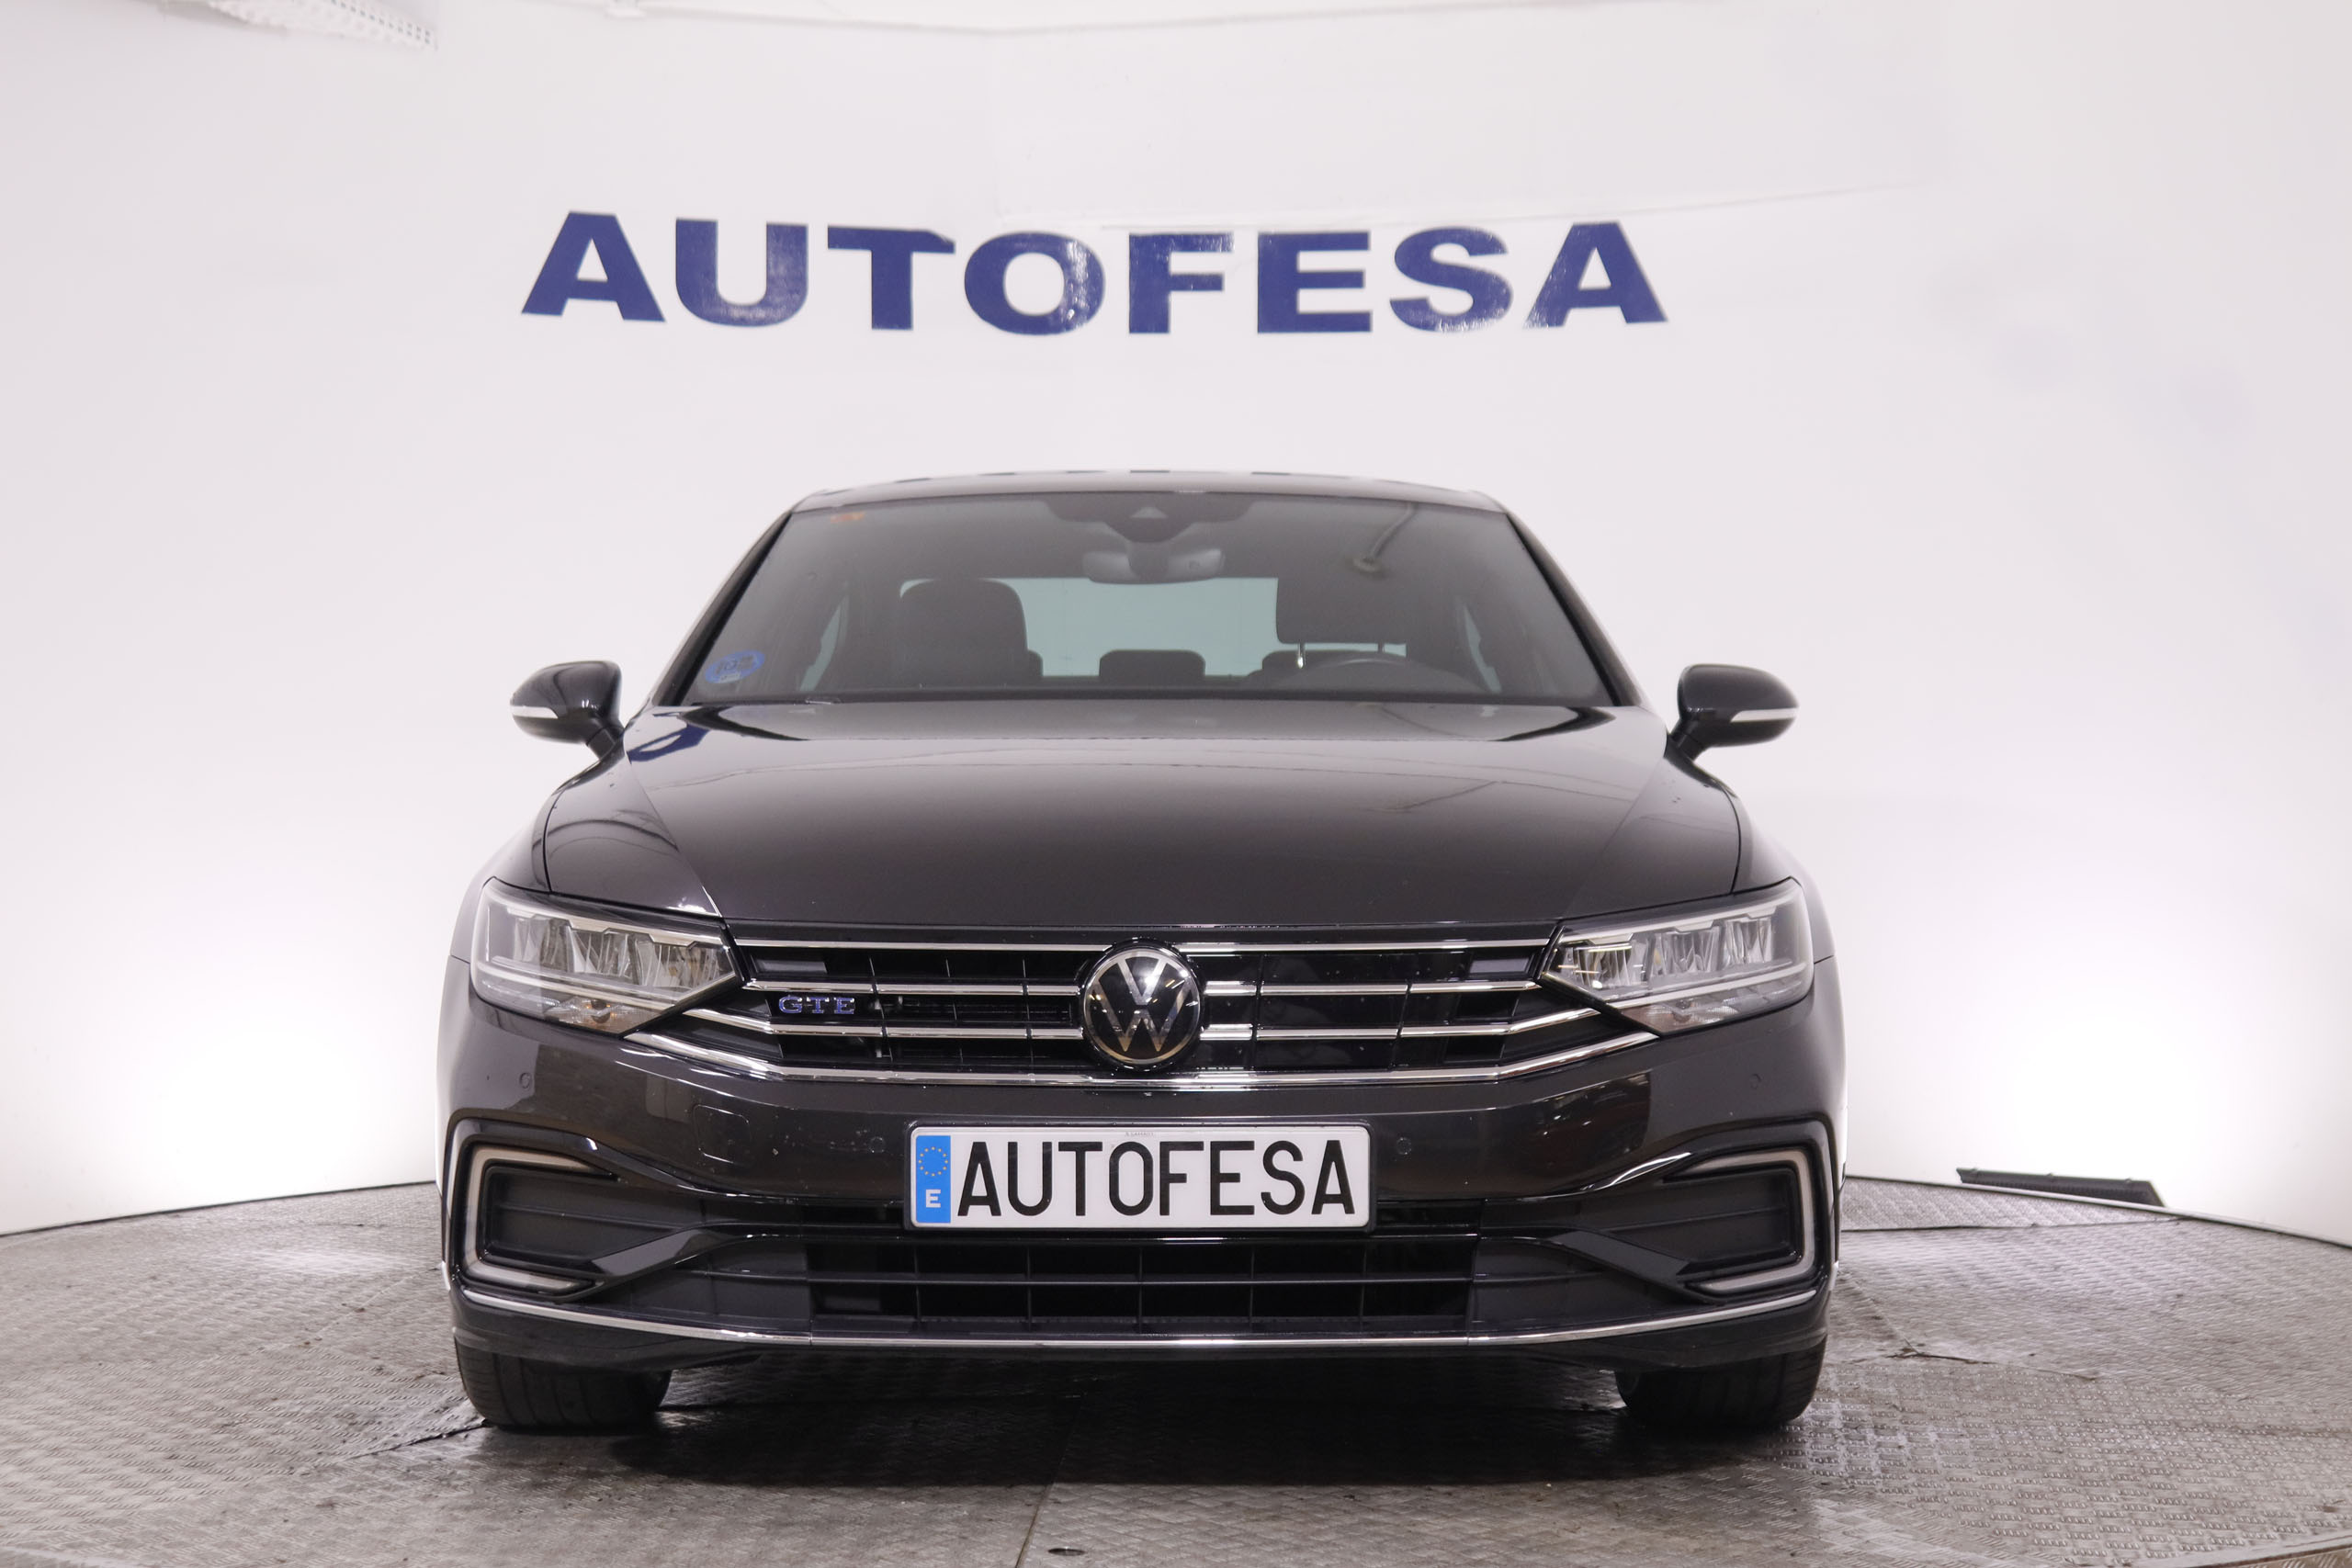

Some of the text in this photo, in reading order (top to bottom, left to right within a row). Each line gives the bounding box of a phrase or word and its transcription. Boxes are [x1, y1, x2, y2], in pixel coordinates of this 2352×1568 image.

[521, 211, 1668, 335] AUTOFESA
[778, 996, 855, 1015] GTE
[925, 1189, 941, 1208] E
[957, 1139, 1355, 1217] AUTOFESA
